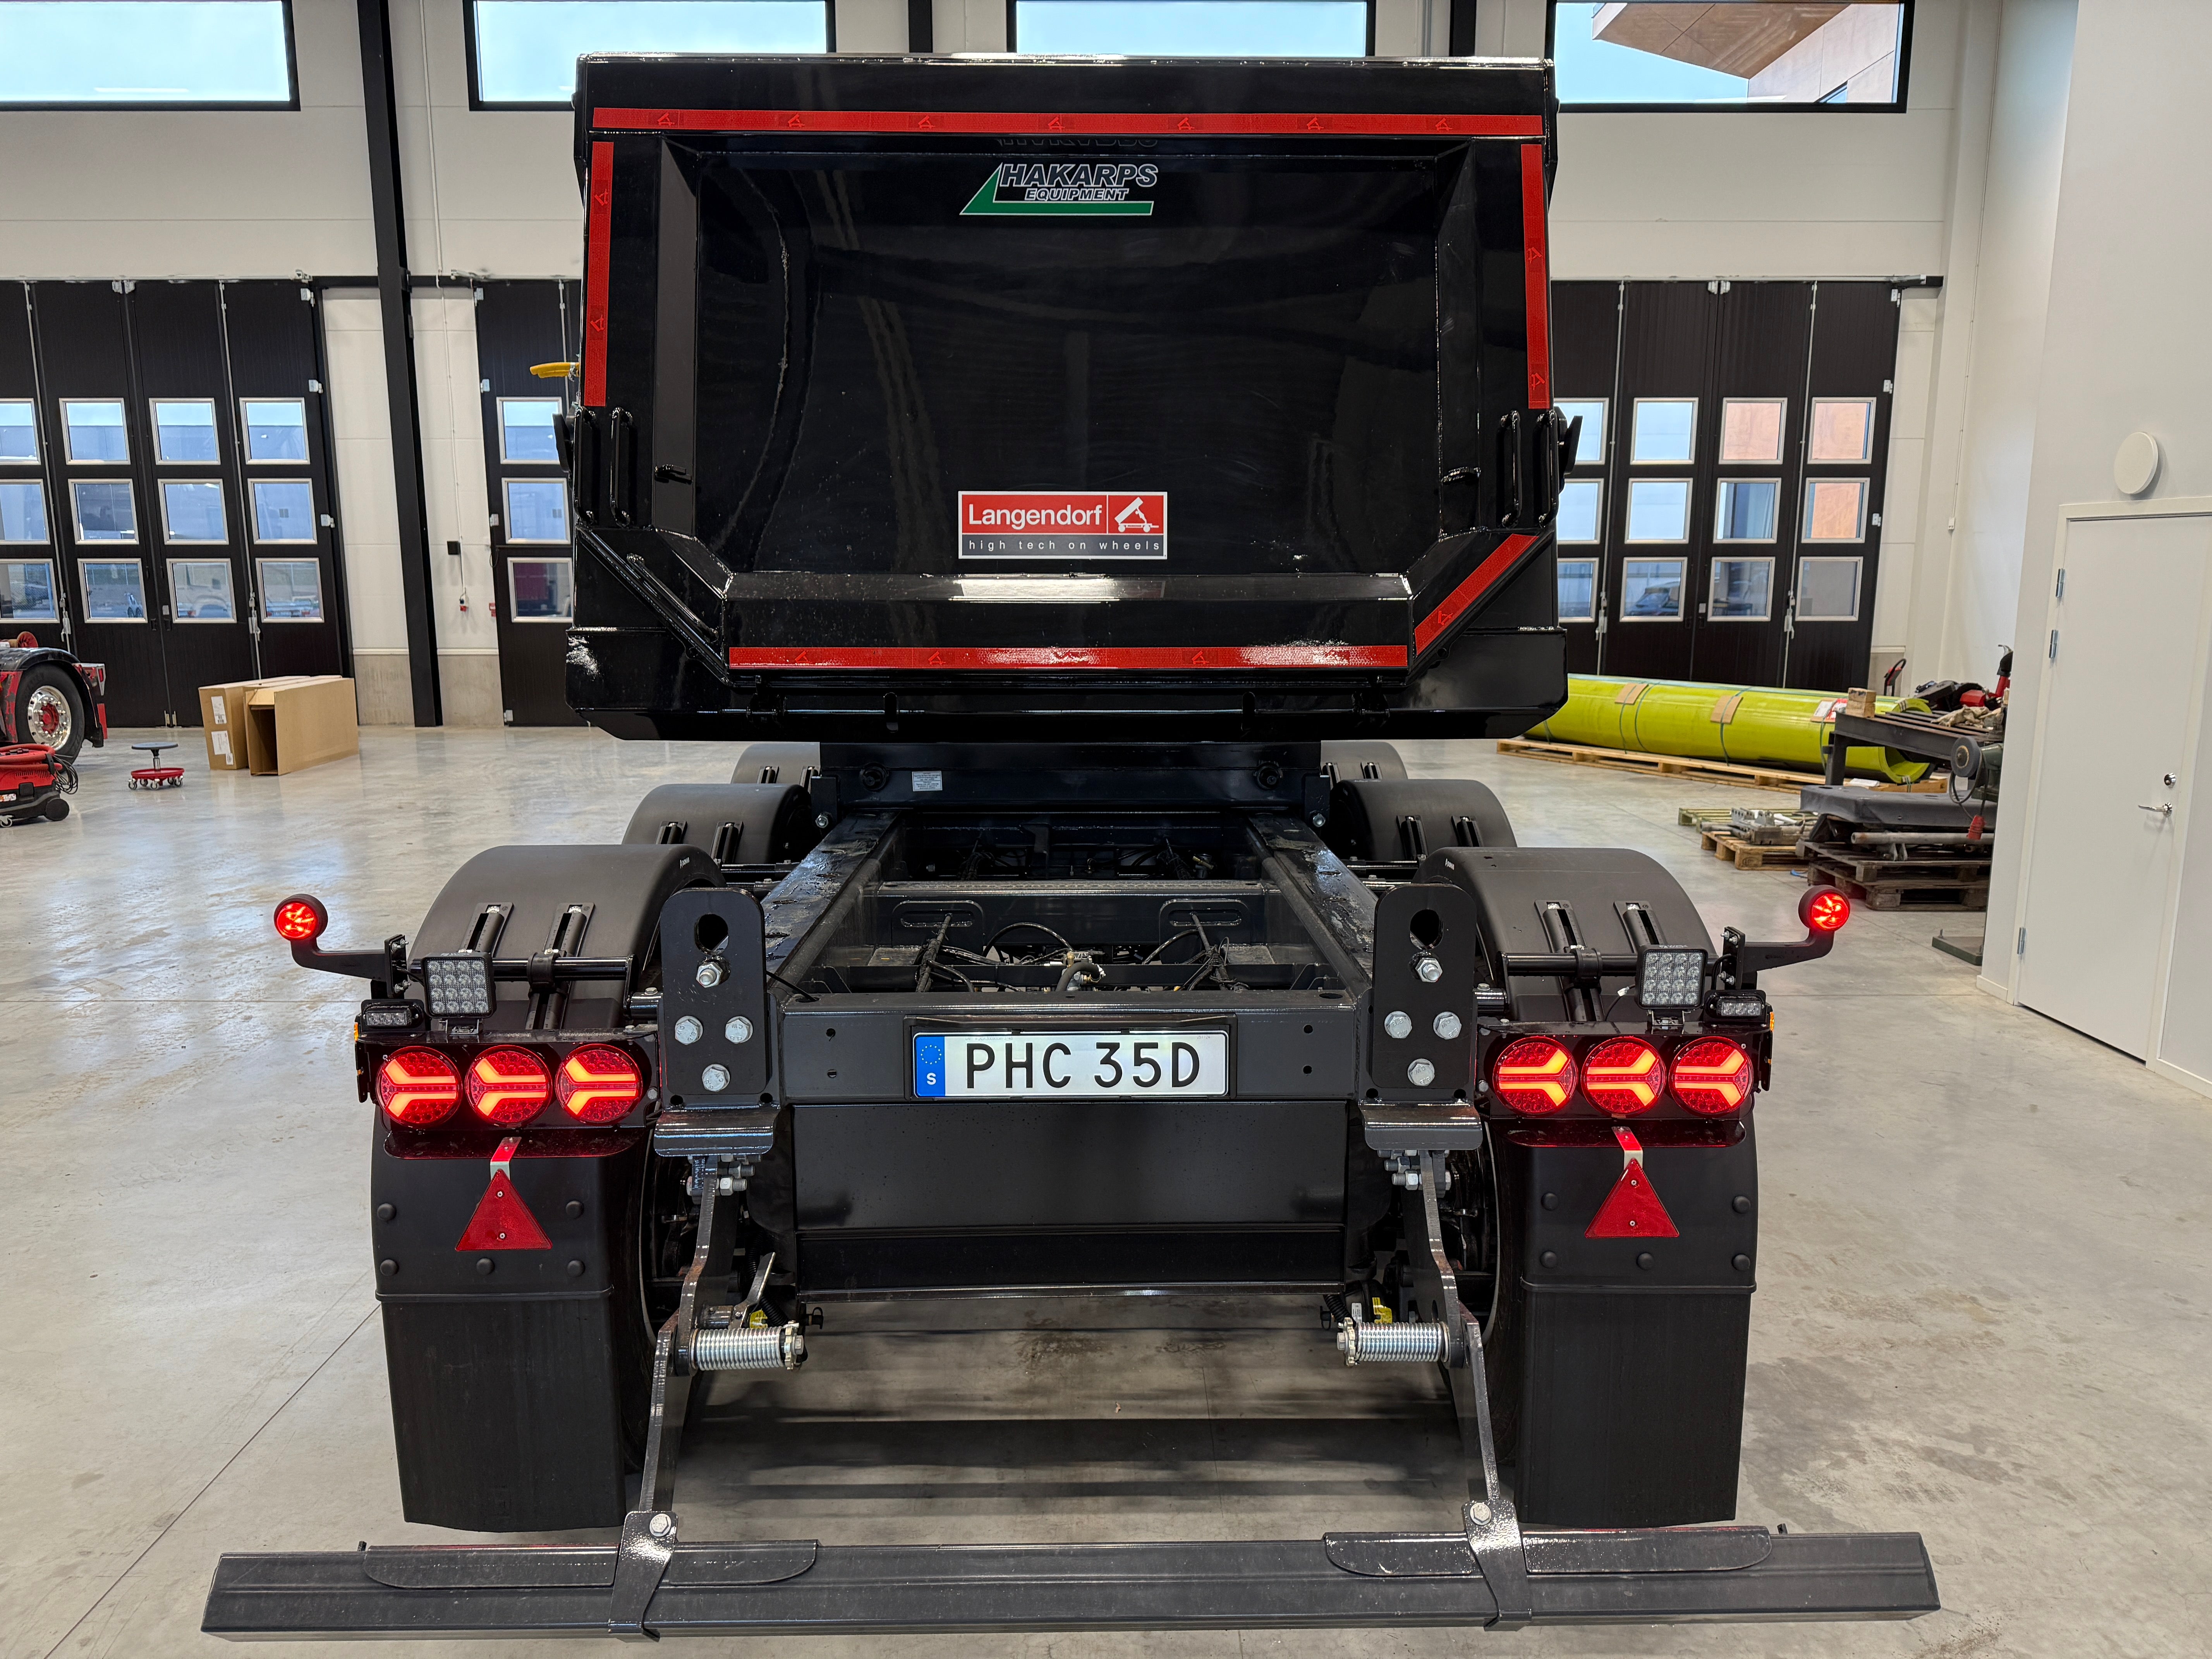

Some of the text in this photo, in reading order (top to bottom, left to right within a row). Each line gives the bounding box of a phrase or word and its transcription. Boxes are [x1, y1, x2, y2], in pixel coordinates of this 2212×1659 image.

[1000, 164, 1158, 187] HAKARPS
[1024, 188, 1129, 201] EQUIPMENT
[969, 504, 1102, 530] Langendorf
[969, 540, 1005, 551] high
[1019, 540, 1055, 550] tech
[1099, 540, 1159, 550] wheels
[967, 1042, 1200, 1089] PHC 35D
[927, 1073, 936, 1085] S
